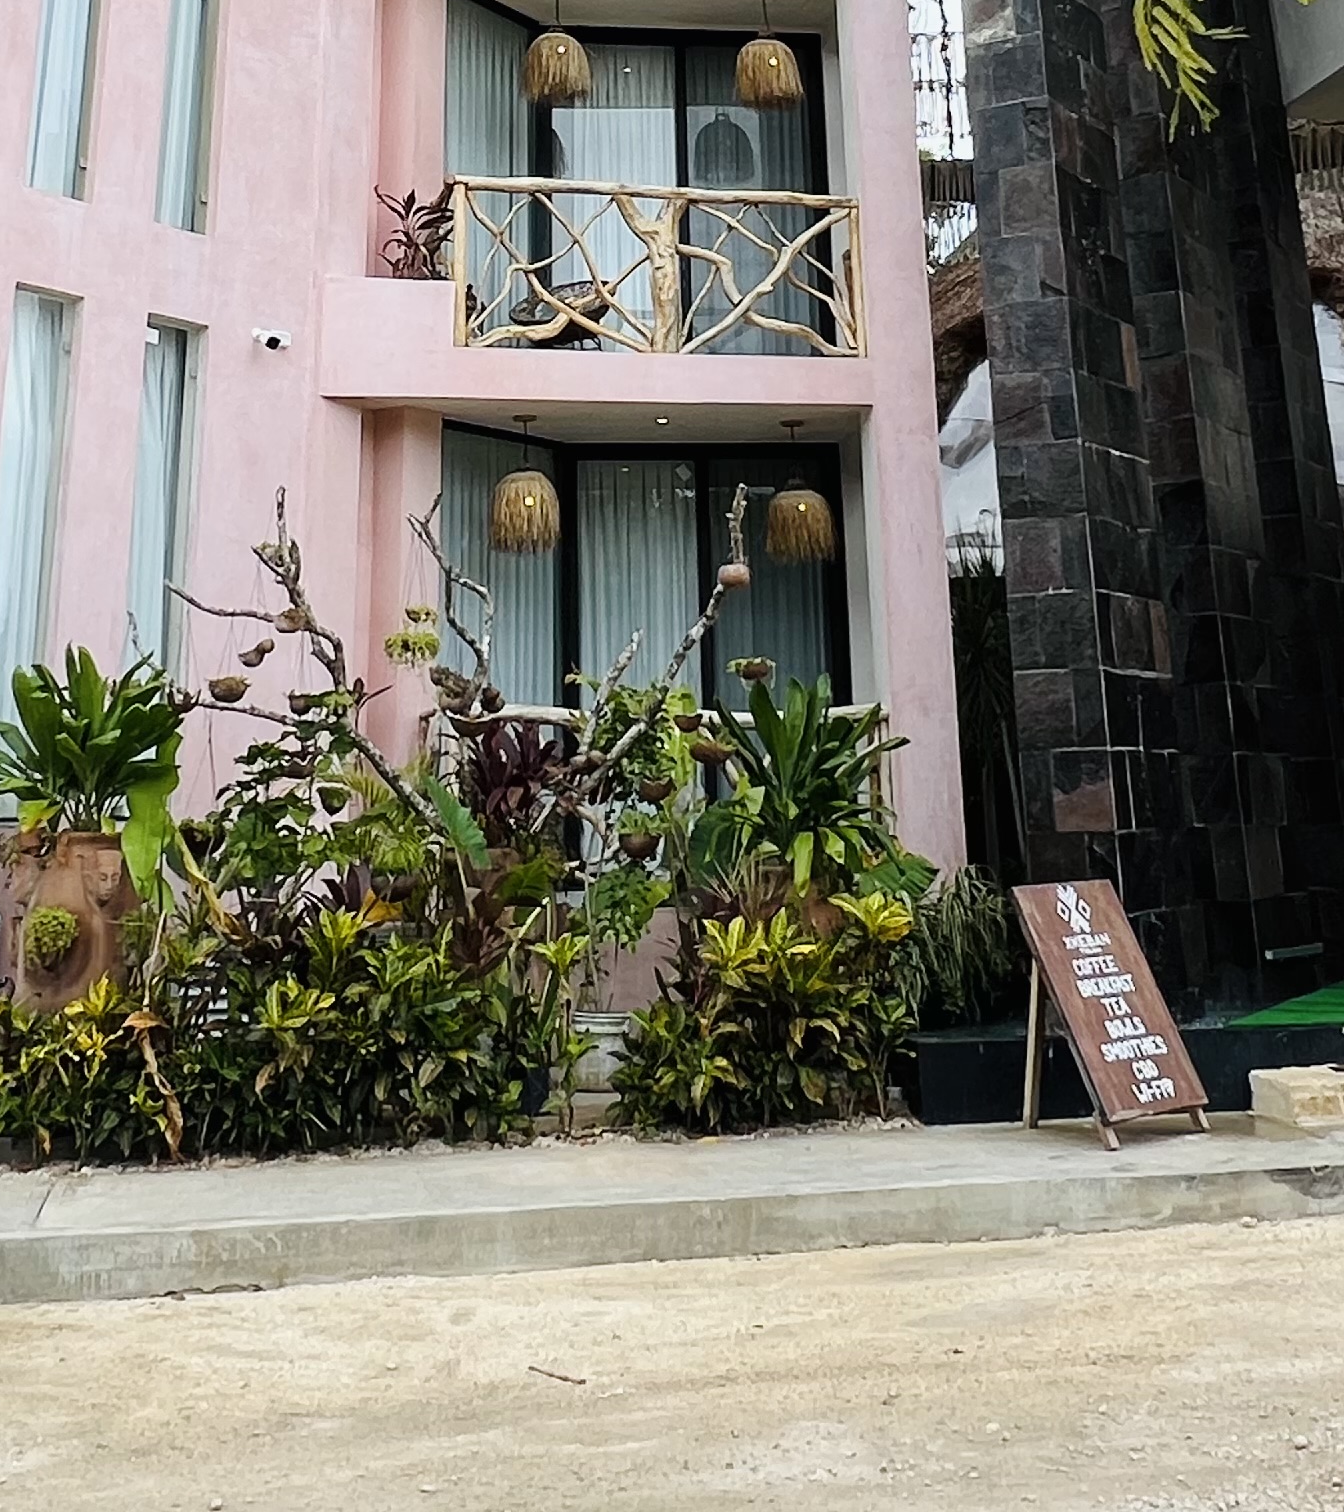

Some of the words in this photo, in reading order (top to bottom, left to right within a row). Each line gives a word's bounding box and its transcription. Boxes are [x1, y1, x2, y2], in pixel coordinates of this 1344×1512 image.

[1072, 955, 1119, 976] COFFEE
[1076, 973, 1136, 998] BREAKFAST
[1099, 996, 1132, 1017] TEA
[1100, 1035, 1168, 1062] SMOOTHIES
